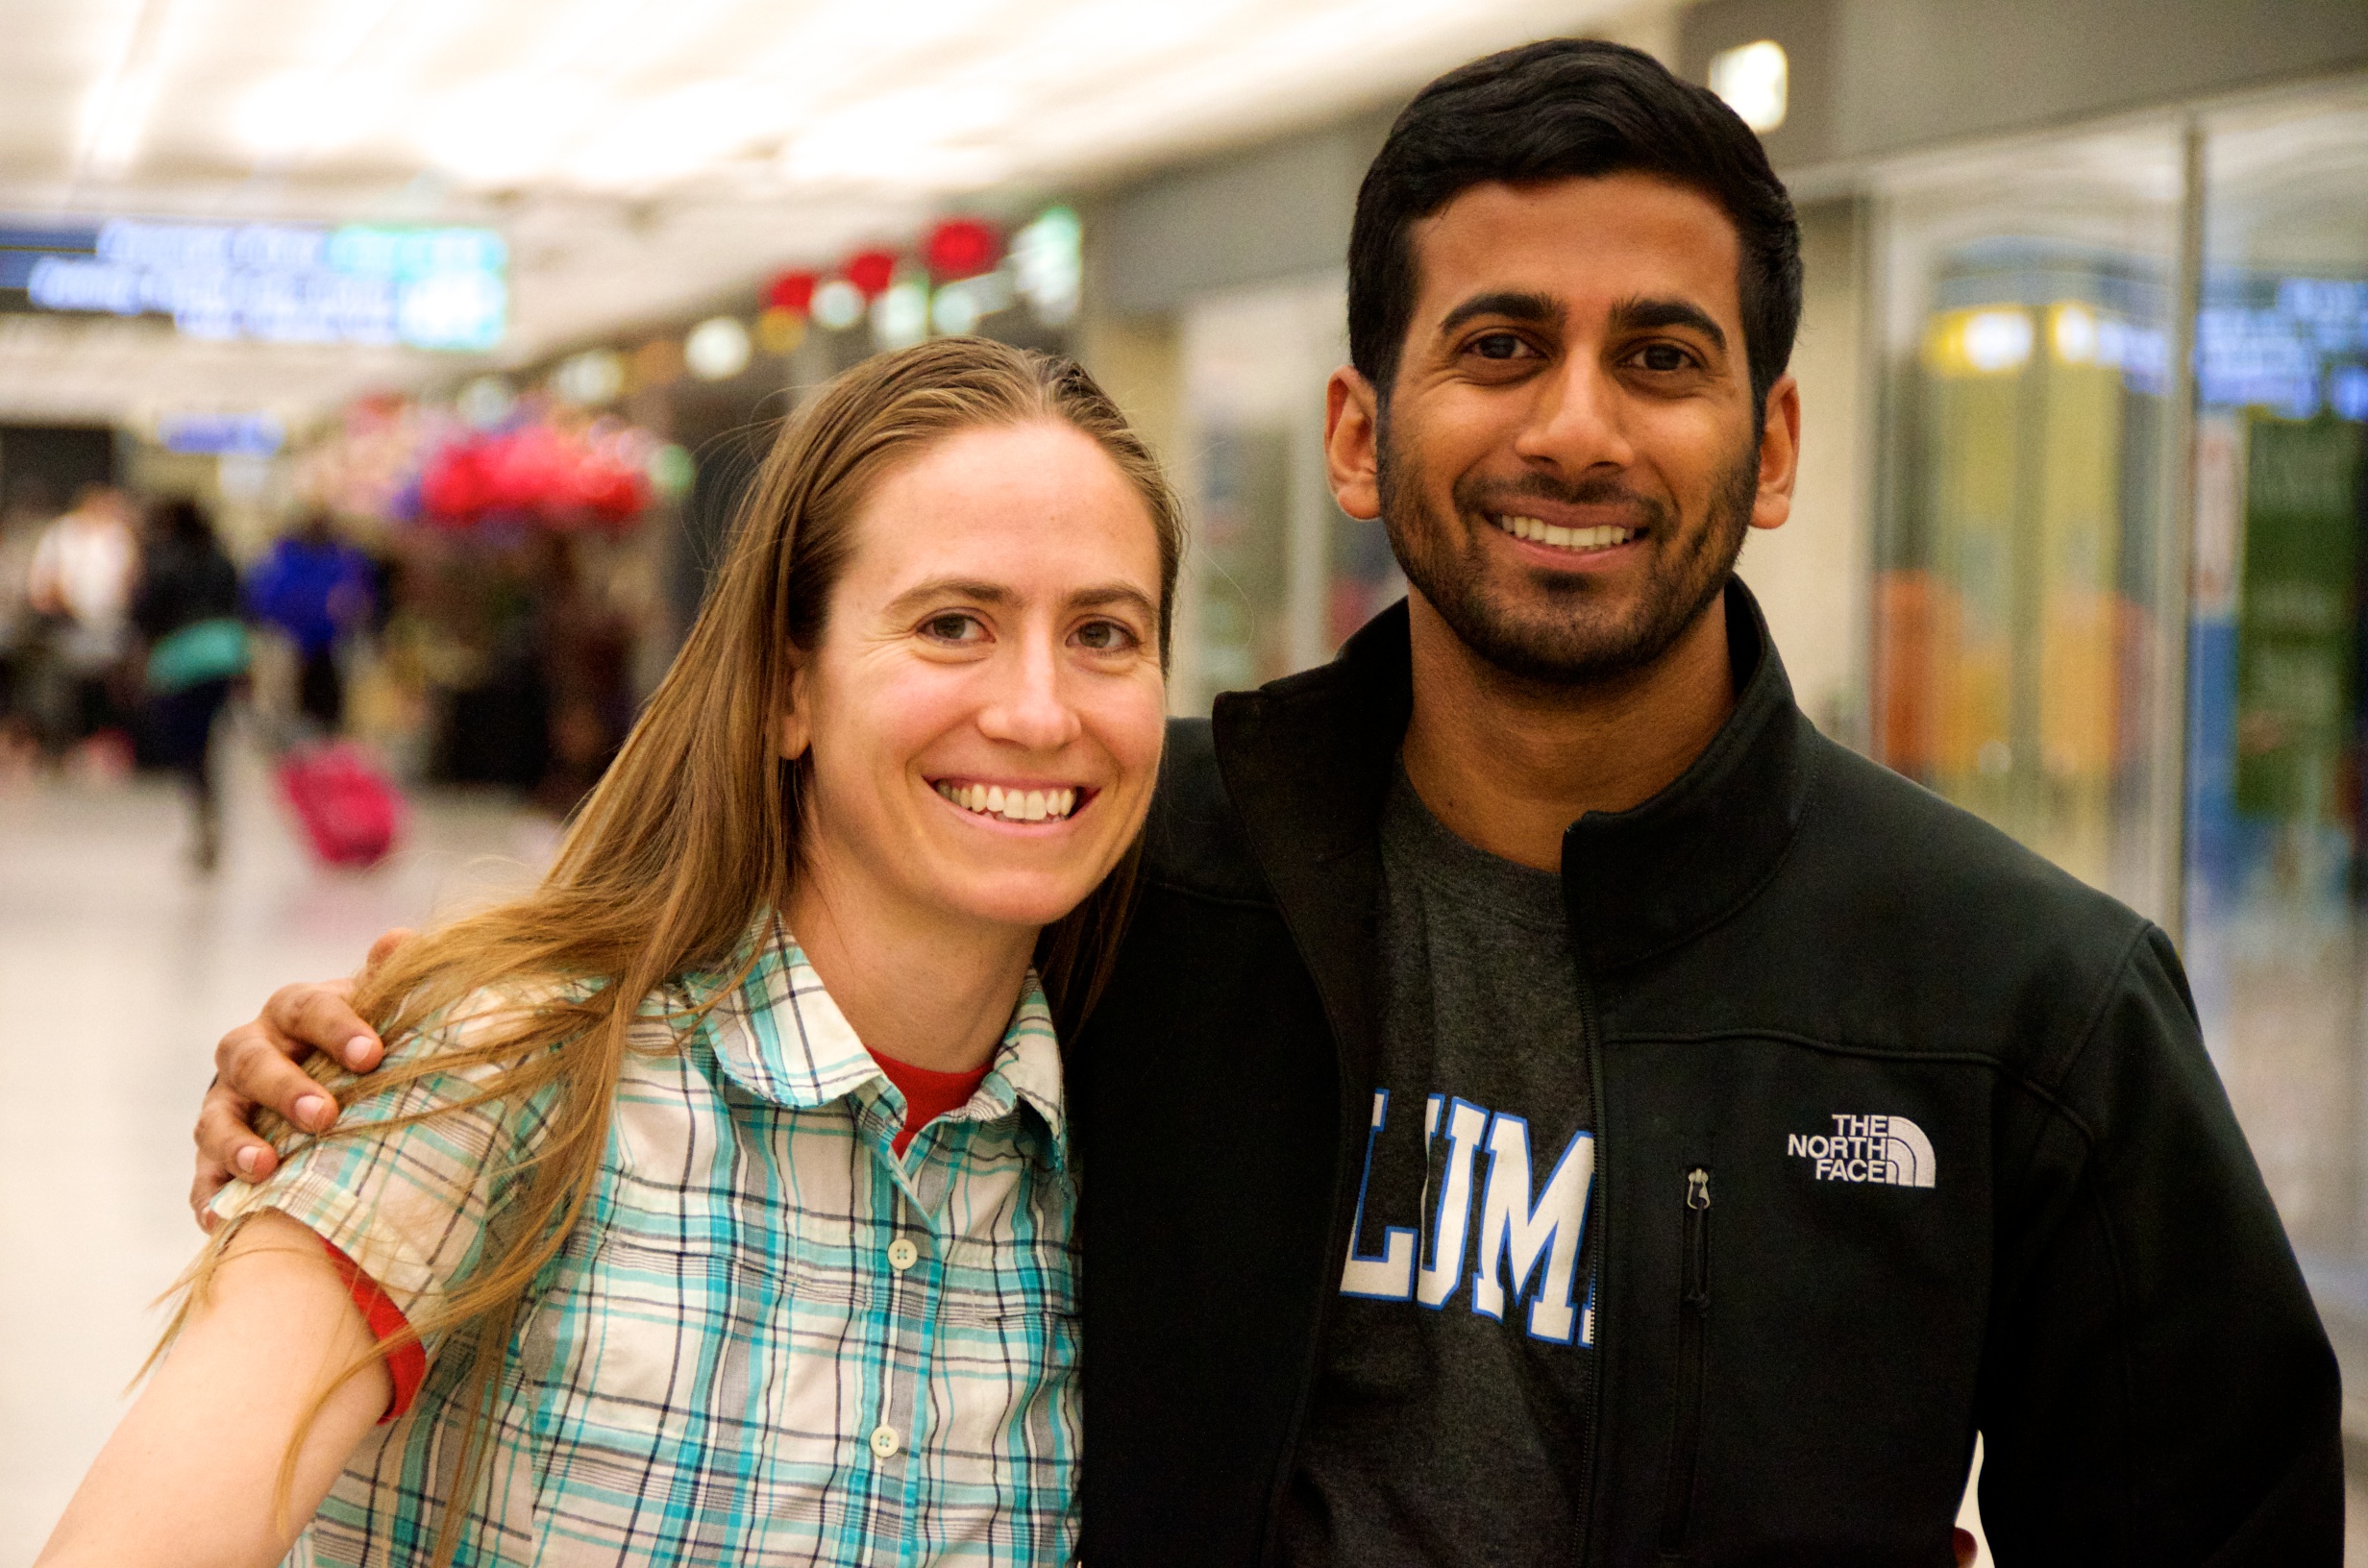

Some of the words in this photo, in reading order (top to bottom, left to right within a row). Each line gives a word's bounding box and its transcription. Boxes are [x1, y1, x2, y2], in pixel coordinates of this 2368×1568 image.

[1831, 1114, 1888, 1138] THE
[1788, 1133, 1887, 1161] NORTH
[1815, 1159, 1887, 1184] FACE
[1339, 1087, 1596, 1349] LUM
